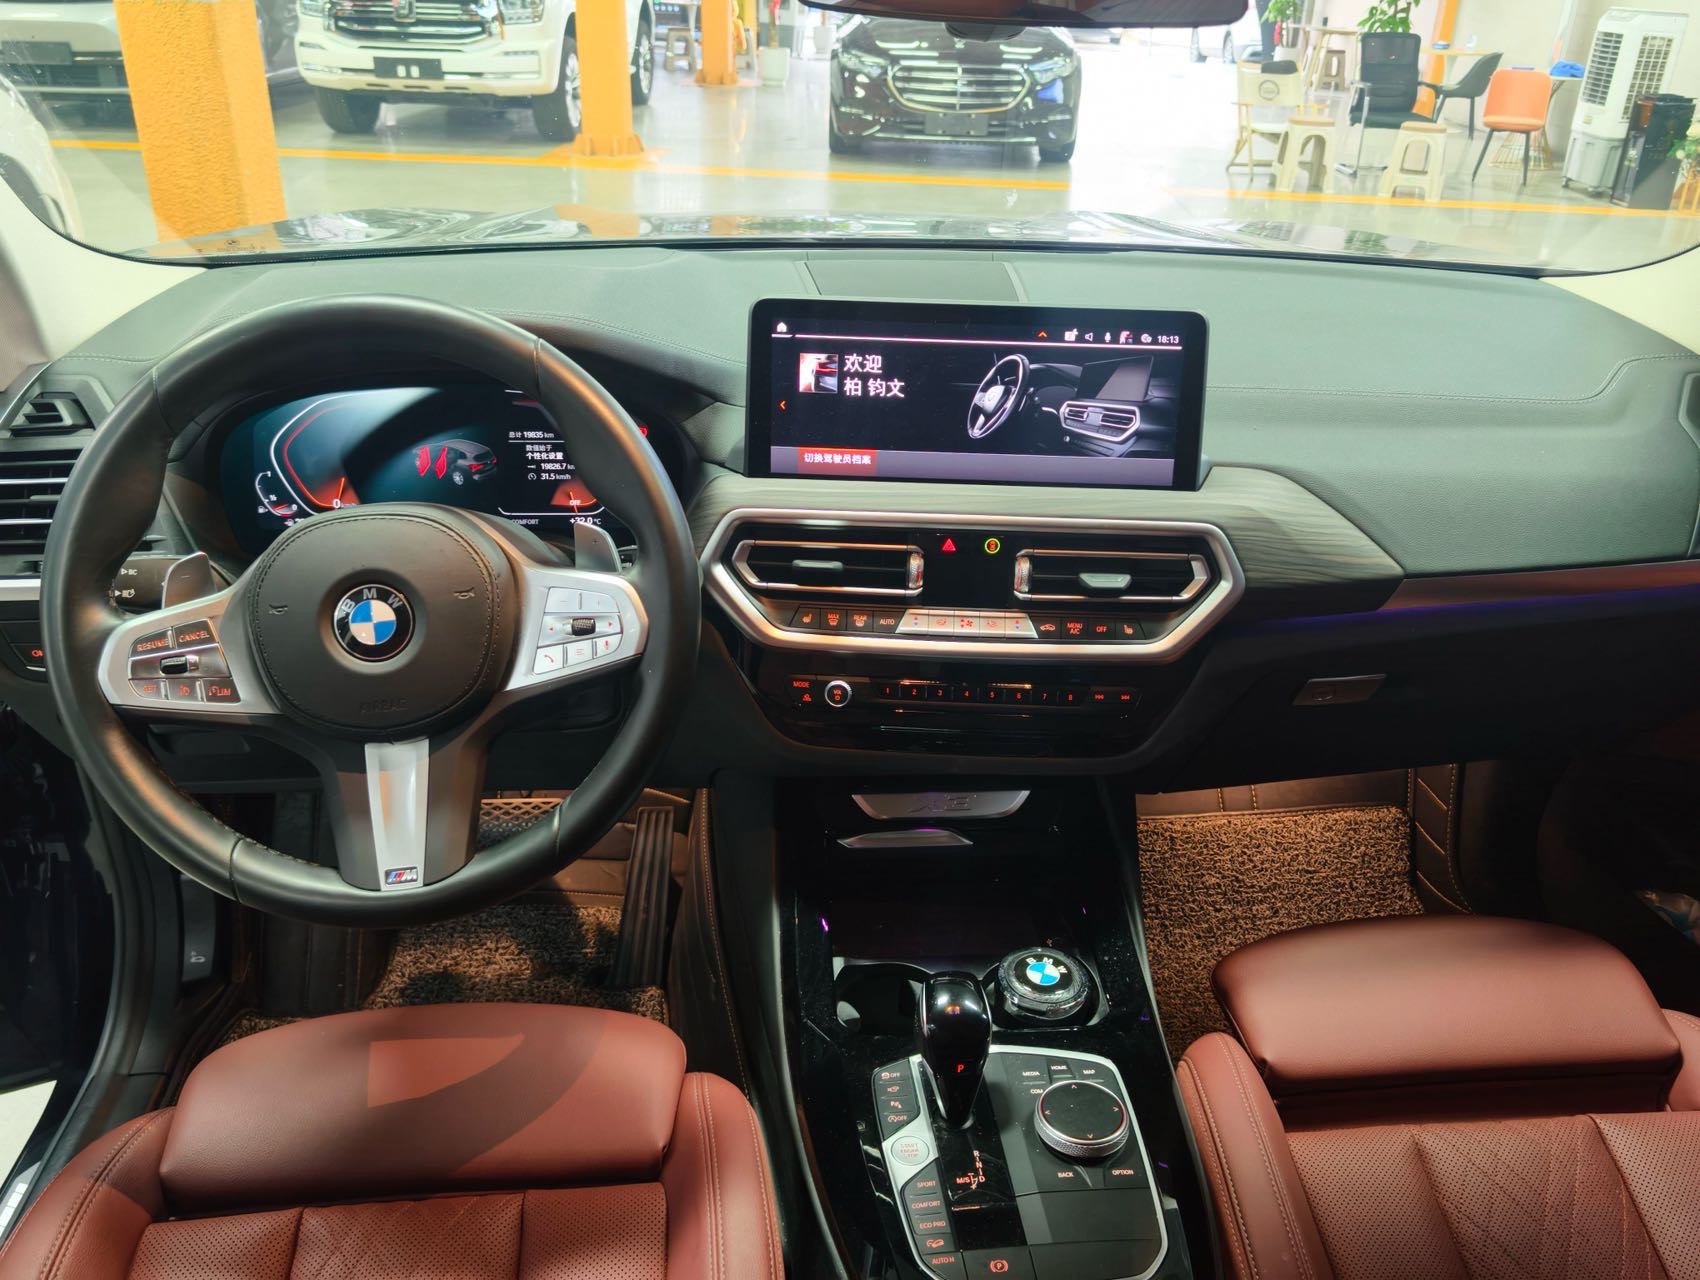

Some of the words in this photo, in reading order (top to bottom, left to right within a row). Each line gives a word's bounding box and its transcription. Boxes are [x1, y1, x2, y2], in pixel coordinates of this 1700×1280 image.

[1157, 335, 1179, 344] 18:13
[844, 353, 882, 373] 欢迎
[844, 376, 862, 396] 柏
[867, 377, 905, 397] 钧文
[508, 431, 521, 439] 总计
[523, 431, 544, 439] 19835
[525, 452, 564, 460] 个性化设置
[804, 452, 872, 465] 切换驾驶员档案
[332, 499, 341, 509] 0
[341, 587, 403, 613] BMW
[1096, 625, 1107, 633] OFF
[179, 631, 210, 643] CANCEL
[136, 638, 170, 651] RESUME
[1026, 956, 1068, 973] BMW
[957, 1064, 964, 1072] P
[911, 1201, 941, 1209] COMFORT
[933, 1220, 946, 1228] PRO
[932, 1257, 949, 1265] AUTO
